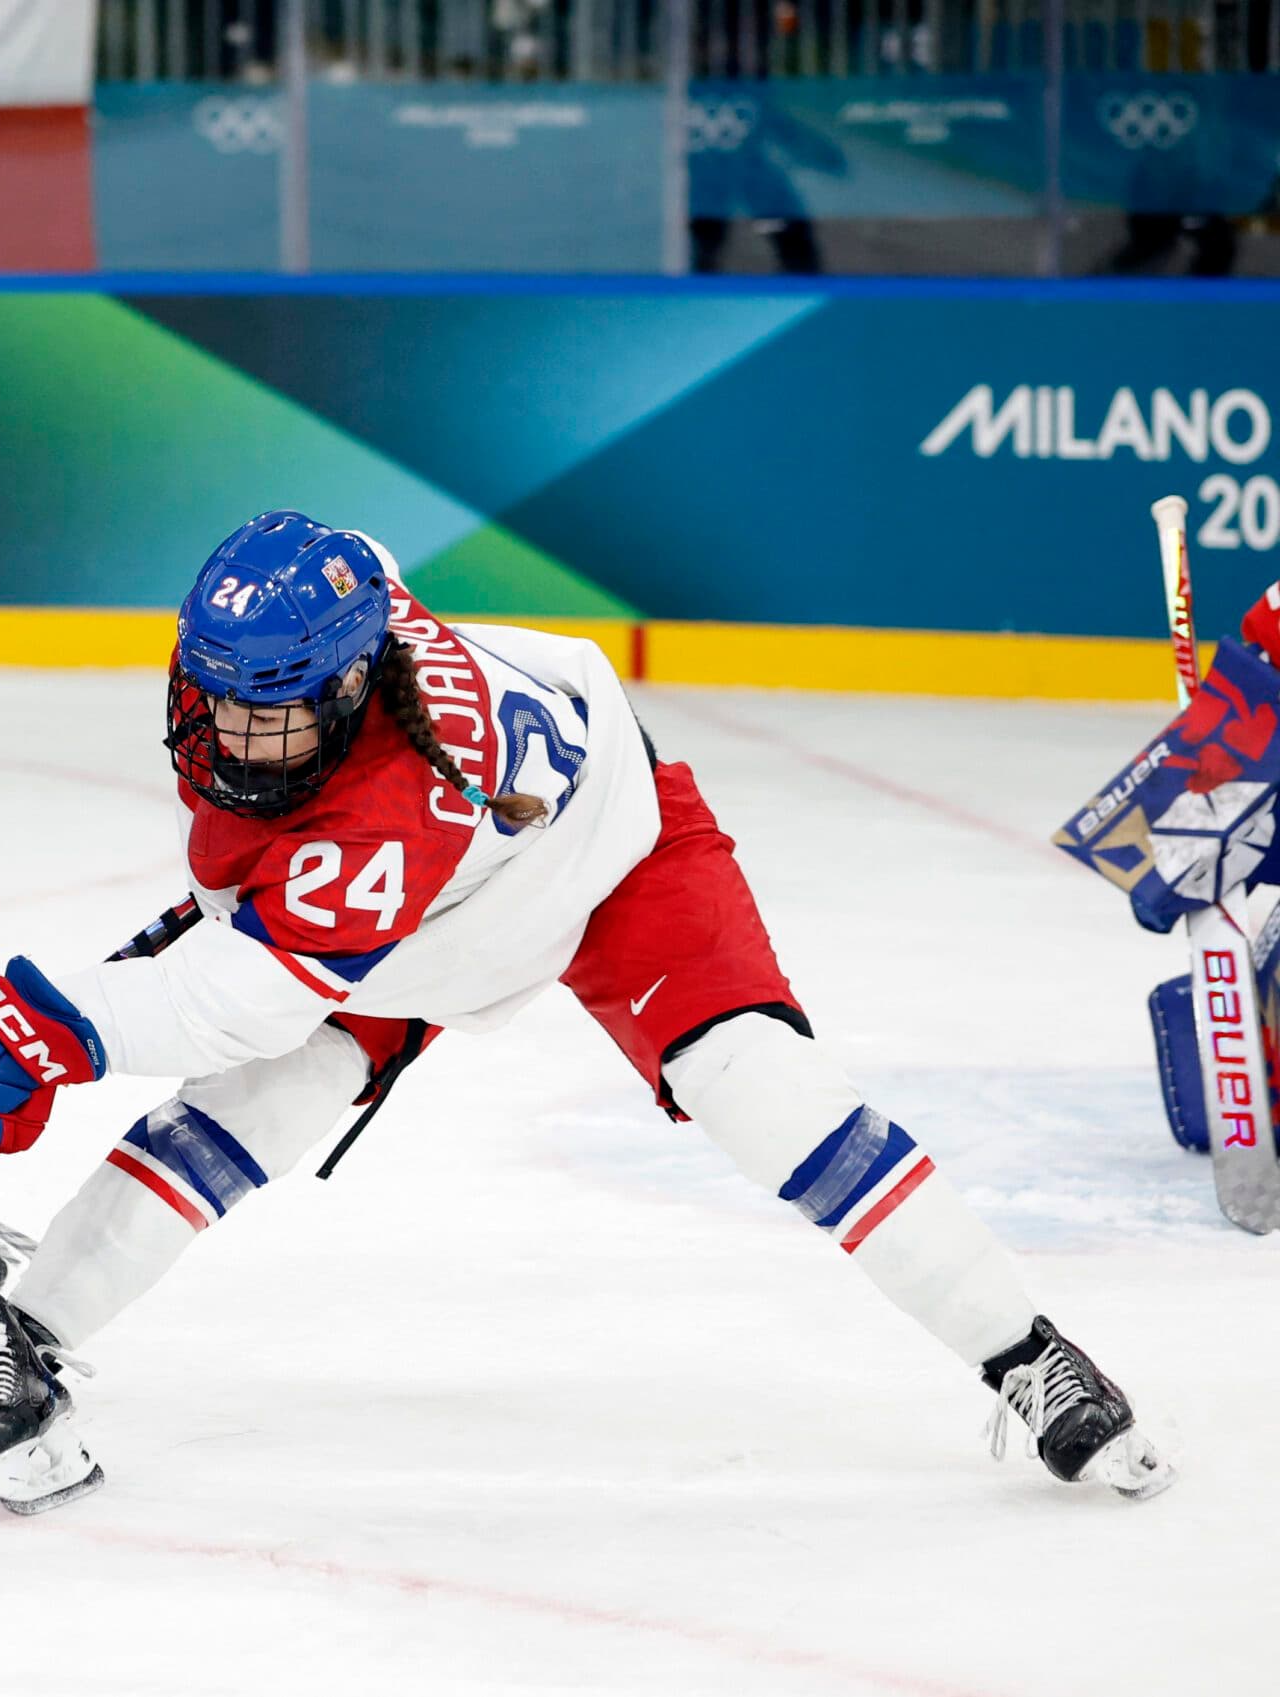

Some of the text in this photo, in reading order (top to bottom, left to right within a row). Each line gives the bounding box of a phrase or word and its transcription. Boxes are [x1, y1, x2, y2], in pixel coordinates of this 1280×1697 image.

[919, 383, 1272, 465] MILANO
[212, 576, 257, 617] 24
[387, 584, 487, 829] CAJANOV
[284, 839, 406, 932] 24
[1202, 949, 1258, 1150] BAUER
